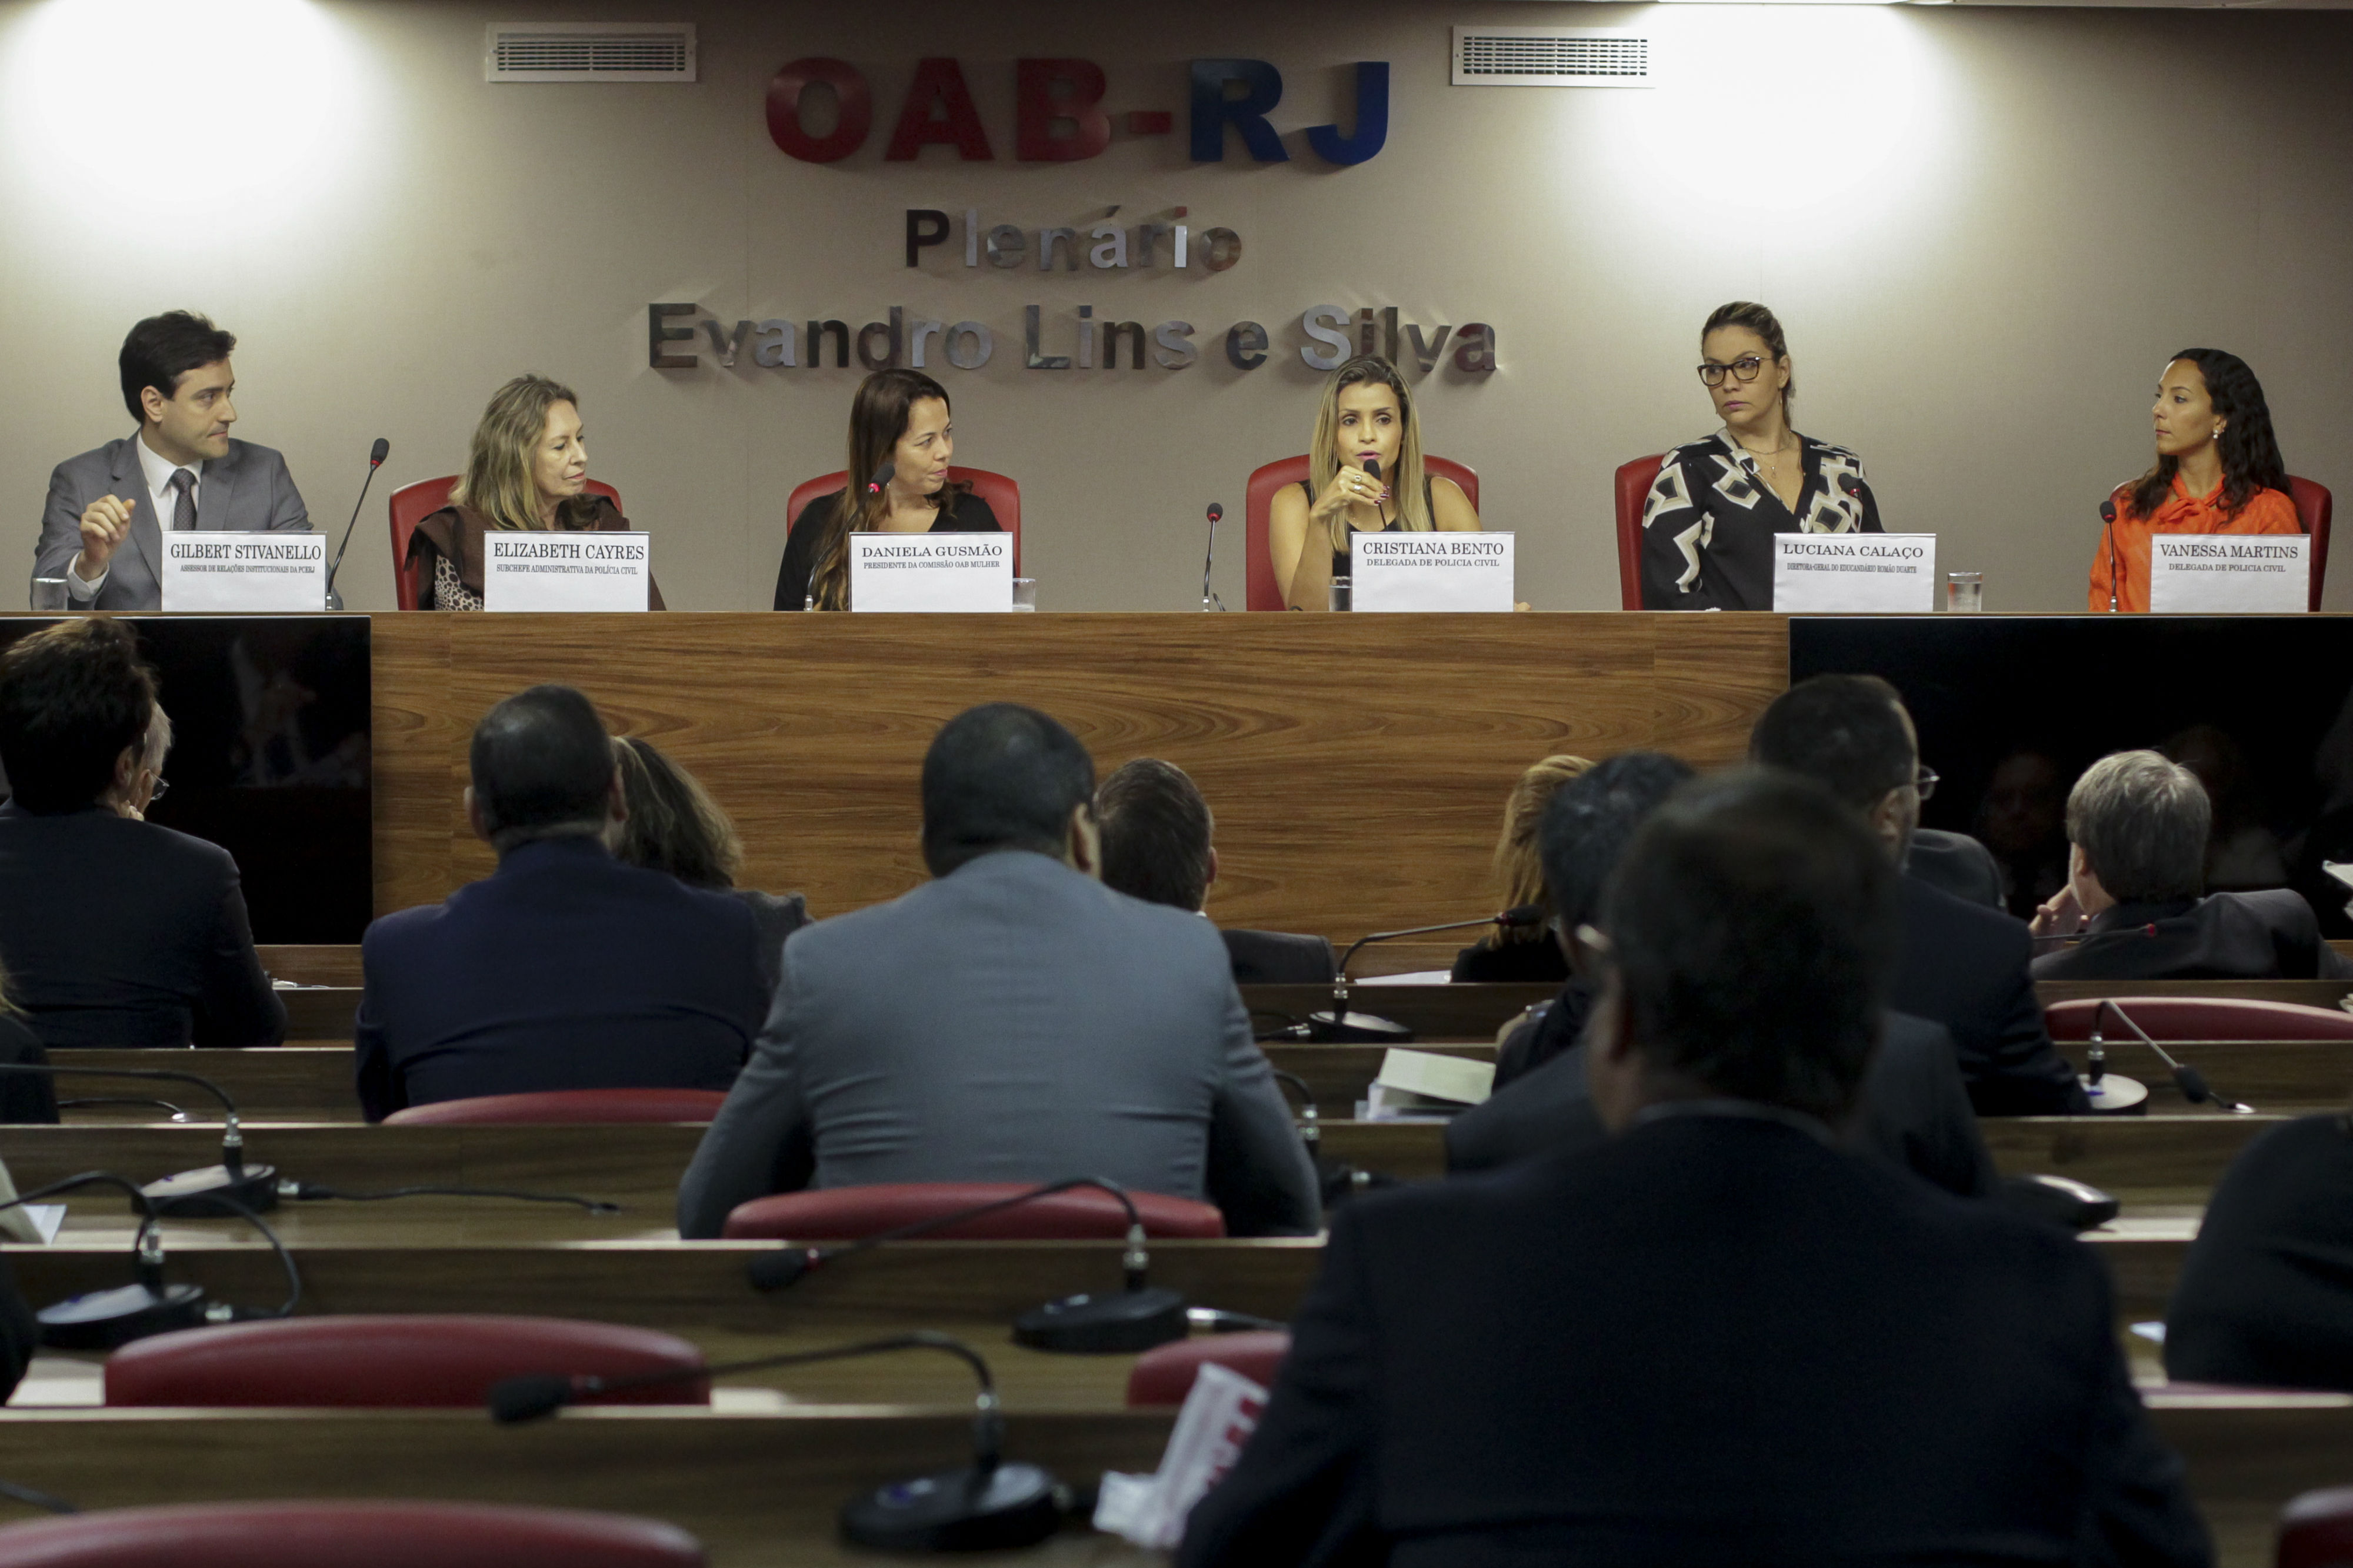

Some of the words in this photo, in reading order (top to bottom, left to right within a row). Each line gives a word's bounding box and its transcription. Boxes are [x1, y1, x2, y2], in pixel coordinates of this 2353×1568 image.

[765, 57, 1390, 166] OAB-RJ
[906, 206, 1242, 271] Plenário
[649, 303, 992, 369] Evandro
[1025, 305, 1197, 369] Lins
[1226, 321, 1269, 369] e
[1300, 304, 1497, 372] Silva
[171, 544, 231, 558] GILBERT
[235, 545, 321, 559] STIVANELLO
[494, 543, 580, 558] ELIZABETH
[585, 545, 644, 559] CAYRES
[862, 547, 932, 557] DANIELA
[935, 544, 1002, 556] GUSMÃO
[1364, 542, 1447, 554] CRISTIANA
[1451, 543, 1504, 555] BENTO
[1784, 544, 1855, 556] LUCIANA
[1859, 546, 1923, 559] CALAÇO
[2160, 544, 2227, 557] VANESSA
[2231, 545, 2298, 558] MARTINS
[216, 564, 244, 573] RELAÇÕES
[496, 564, 530, 572] SUBCHEFE
[531, 565, 584, 573] ADMINISTRATIVA
[595, 565, 619, 574] POLÍCIA
